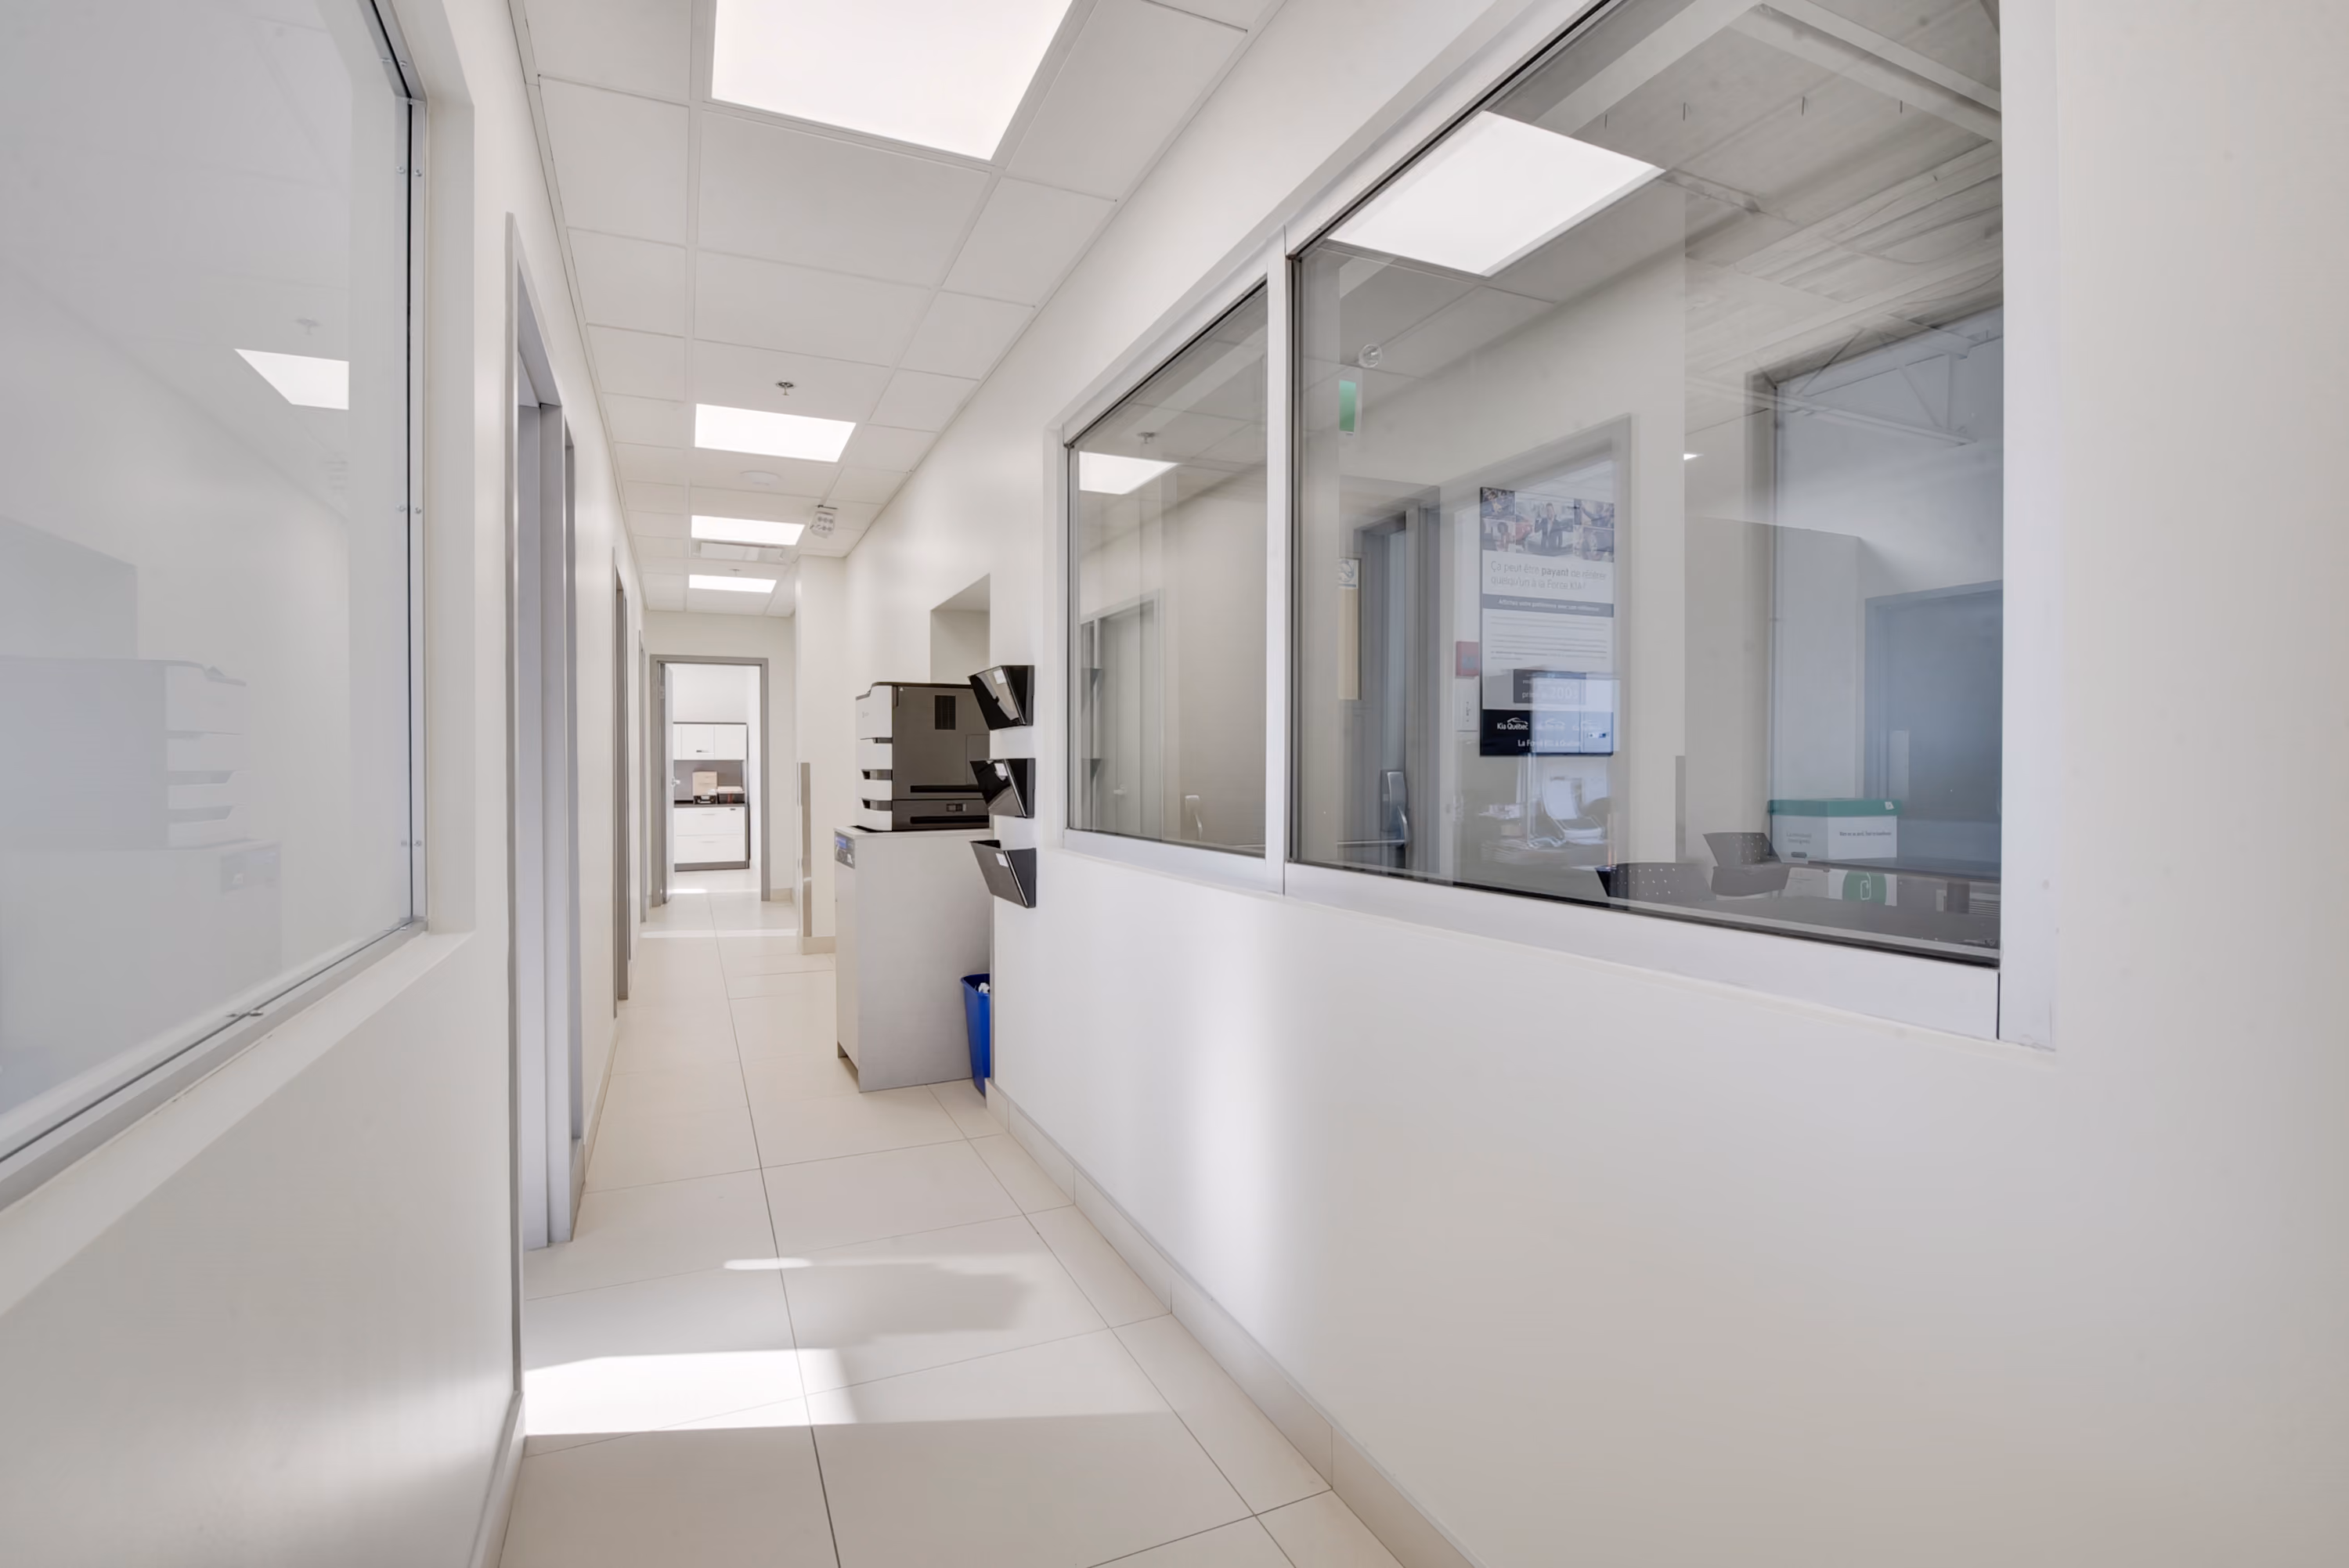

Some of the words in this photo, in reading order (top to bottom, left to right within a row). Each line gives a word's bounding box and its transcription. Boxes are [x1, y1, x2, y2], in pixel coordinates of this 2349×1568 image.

[1491, 561, 1502, 573] Ça
[1503, 564, 1522, 574] peut
[1542, 568, 1568, 578] payant
